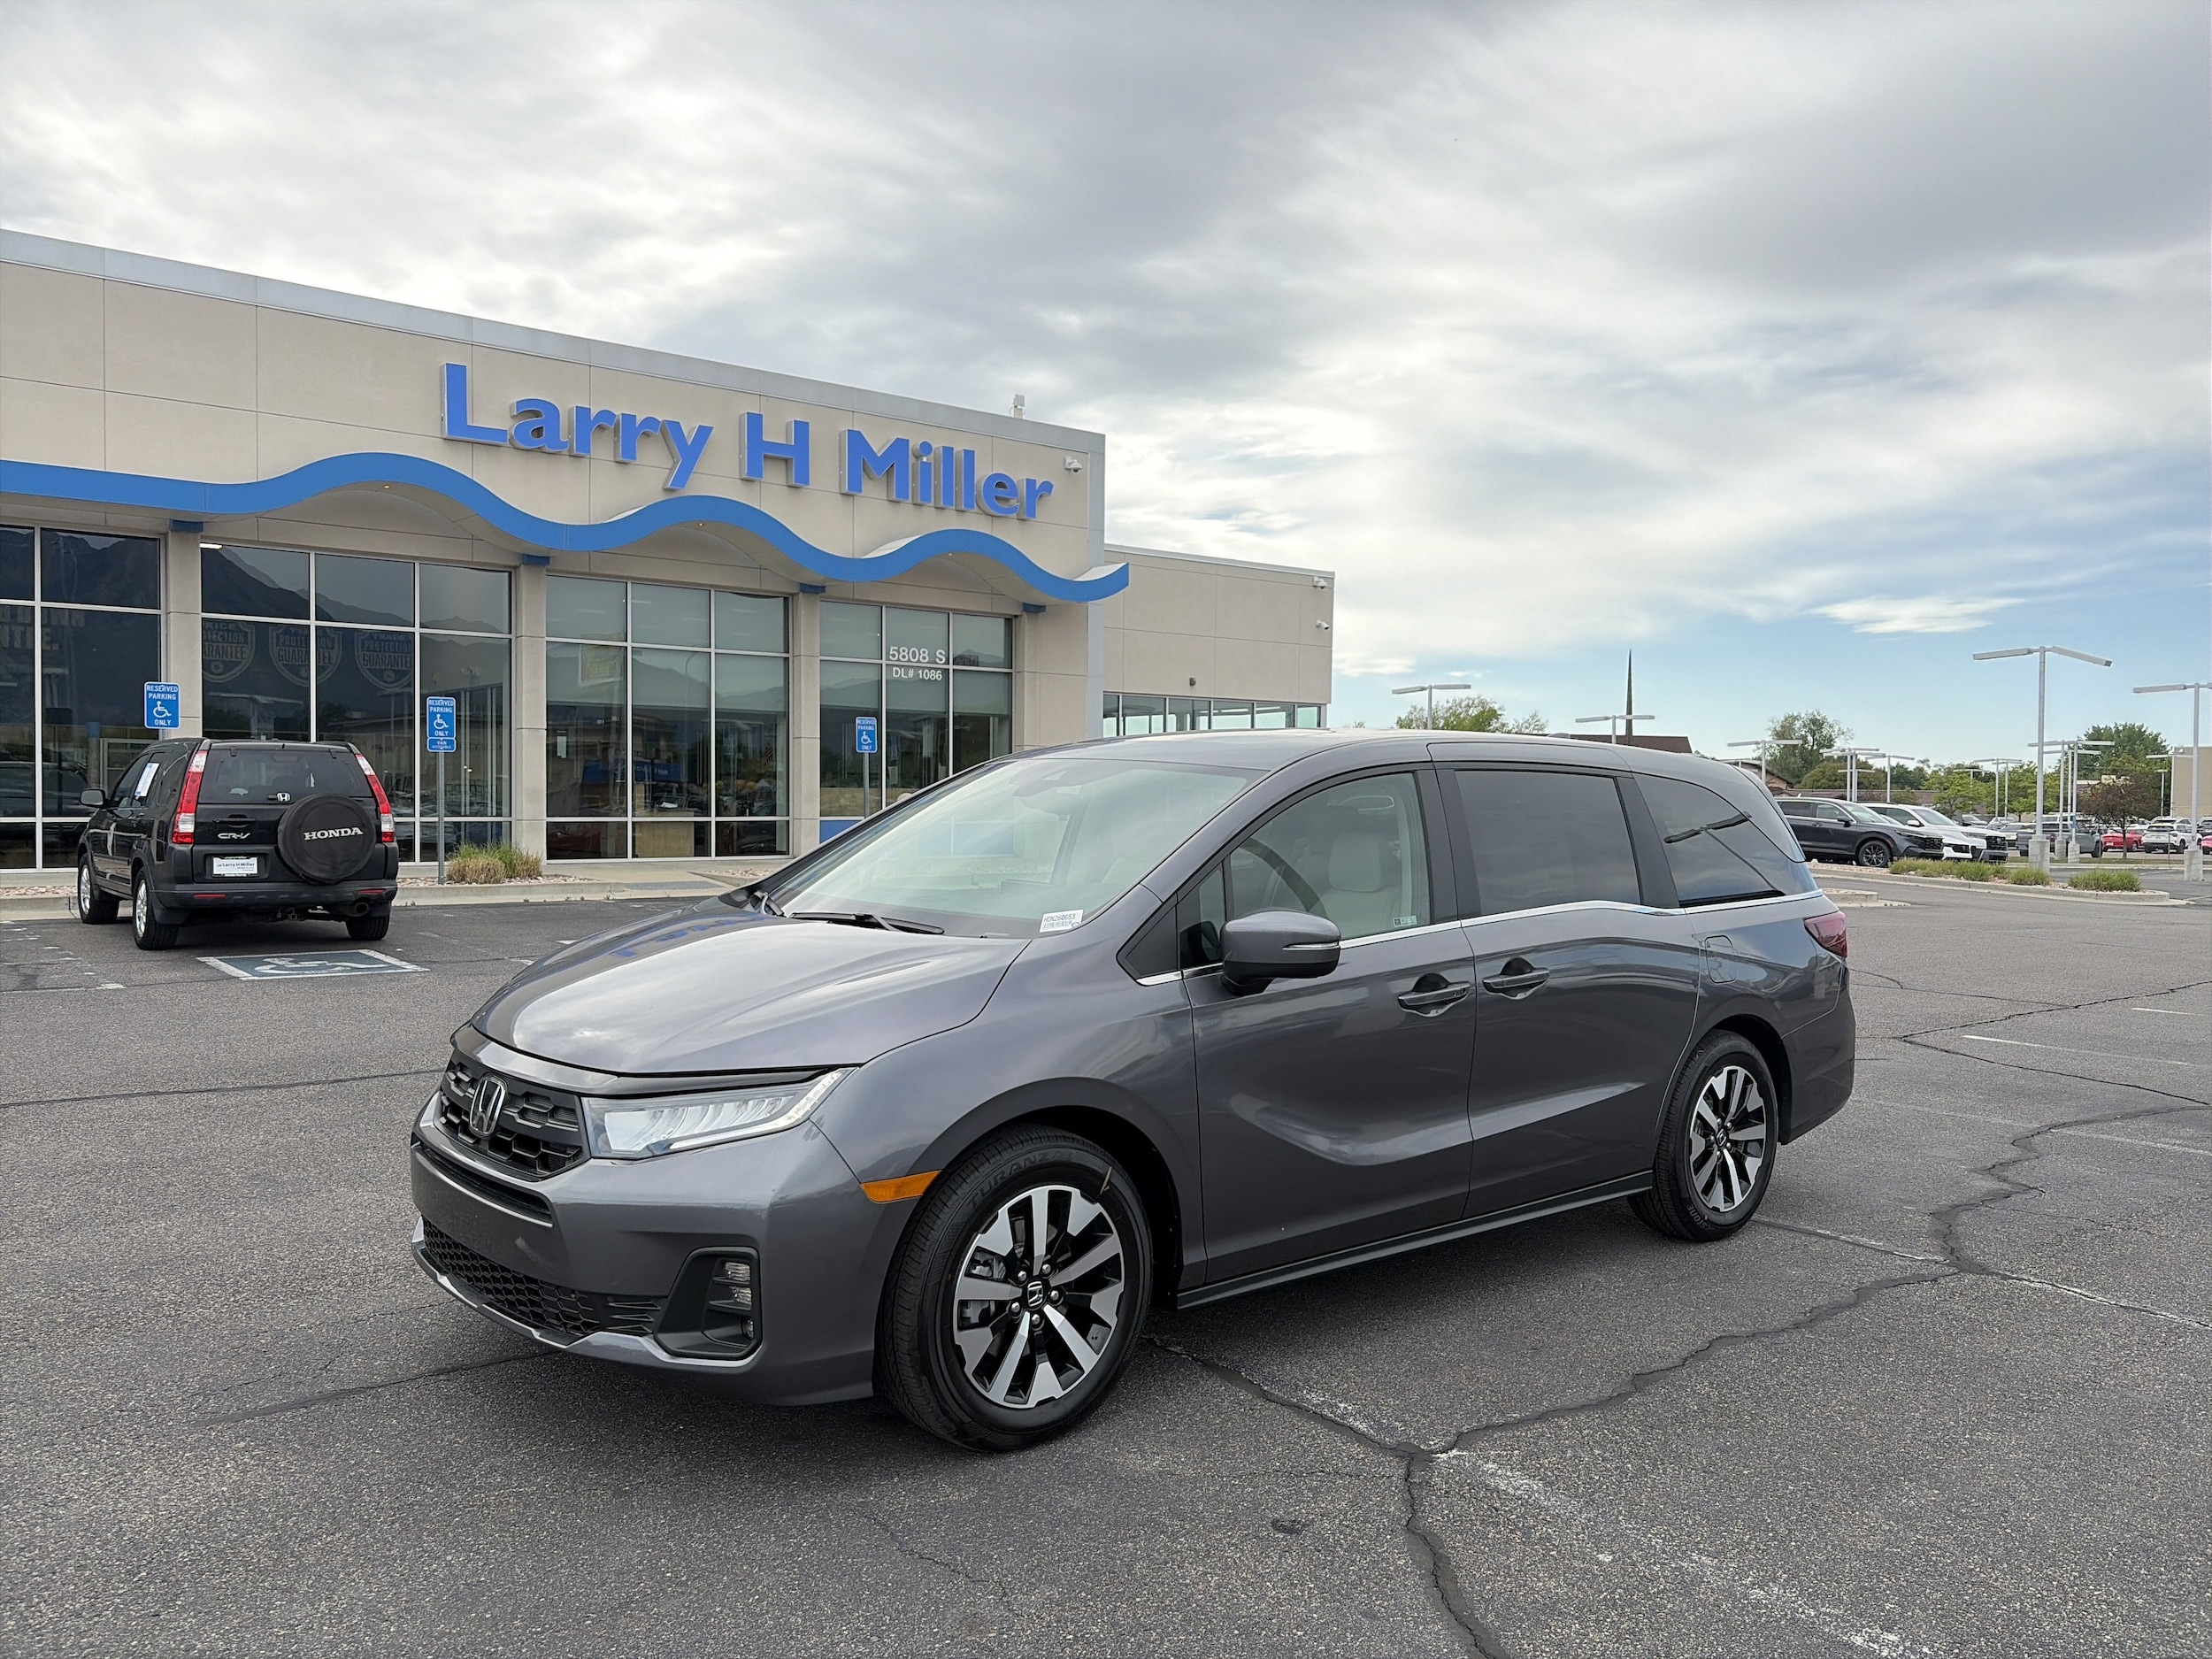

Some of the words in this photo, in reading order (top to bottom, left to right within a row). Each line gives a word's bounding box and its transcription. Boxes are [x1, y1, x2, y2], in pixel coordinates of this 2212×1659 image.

[442, 363, 714, 489] Larry
[740, 411, 810, 487] H
[841, 429, 1054, 519] Miller
[363, 652, 411, 669] GUARANTE
[889, 646, 929, 663] 5808
[935, 649, 946, 664] S
[892, 667, 914, 679] DL#
[918, 669, 942, 680] 1086
[146, 684, 179, 693] RESERVED
[303, 826, 364, 841] HONDA
